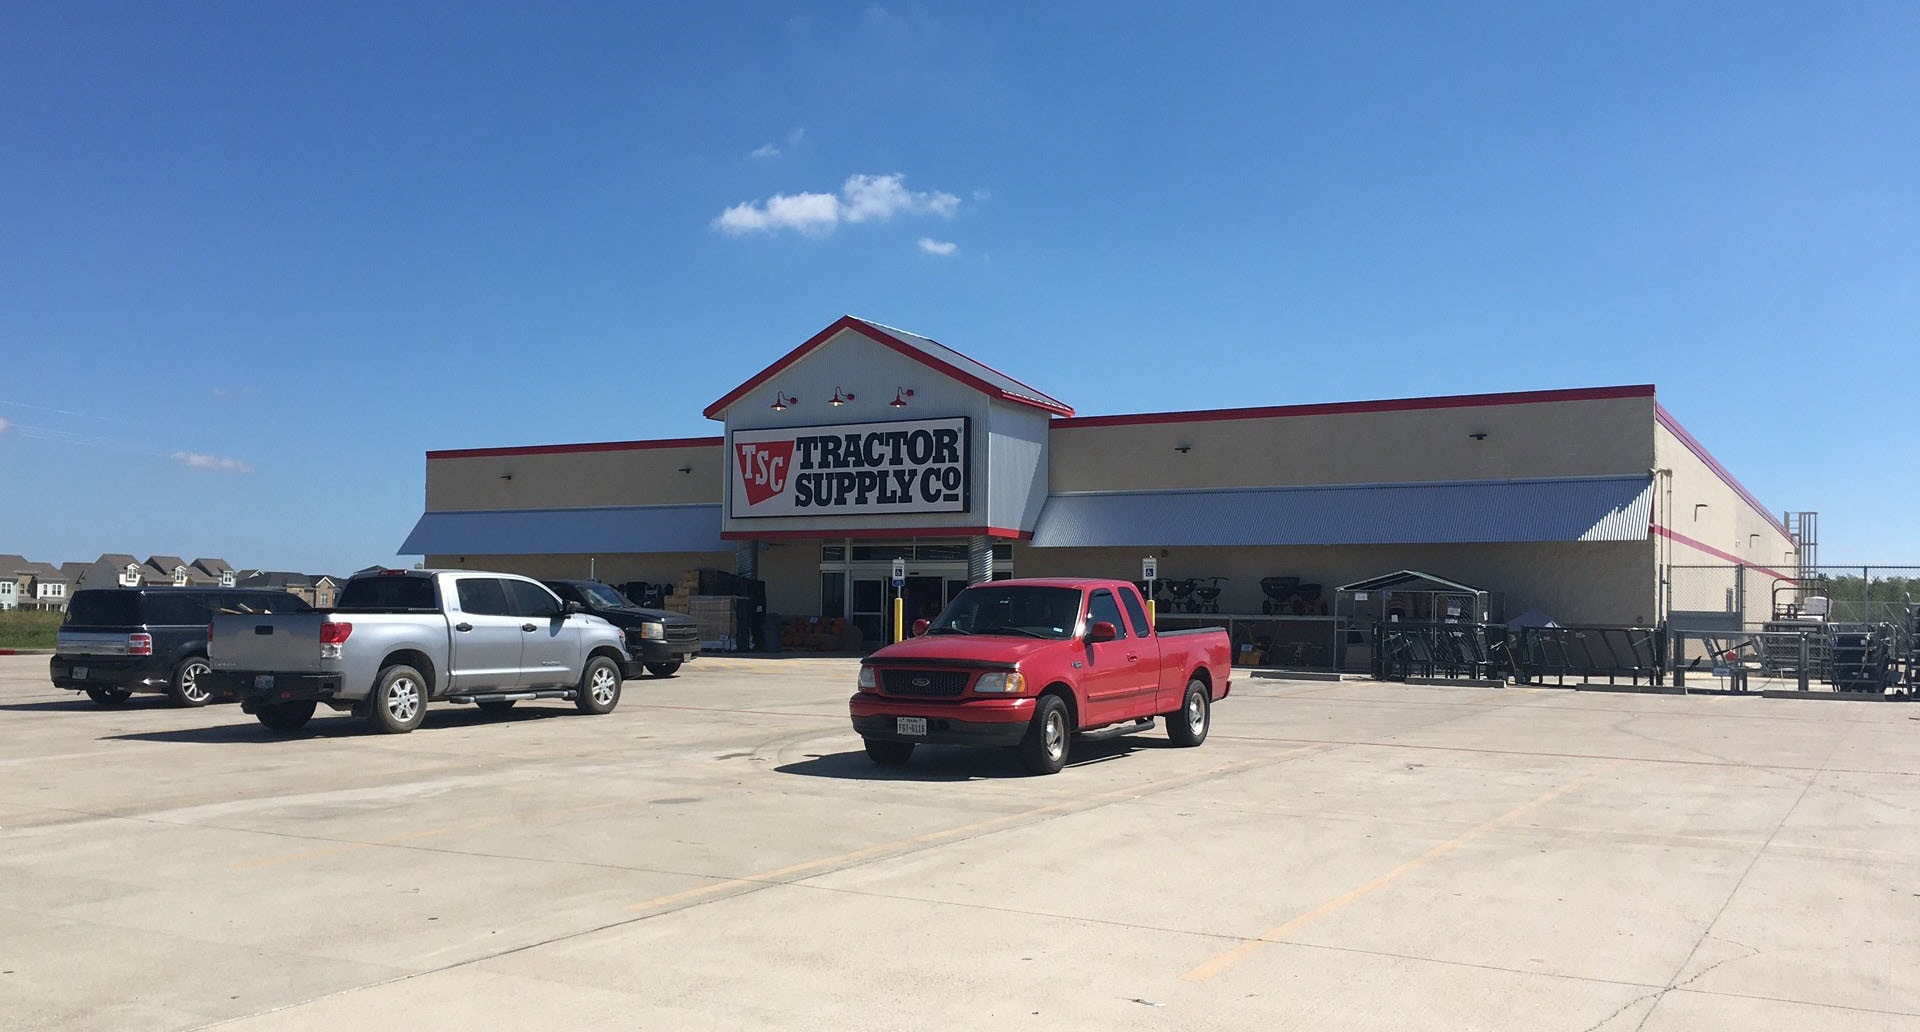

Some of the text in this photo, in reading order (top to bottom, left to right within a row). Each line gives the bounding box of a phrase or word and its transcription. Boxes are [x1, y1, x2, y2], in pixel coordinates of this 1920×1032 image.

[742, 445, 784, 492] TSC
[796, 429, 960, 469] TRACTOR
[795, 469, 917, 507] SUPPLY
